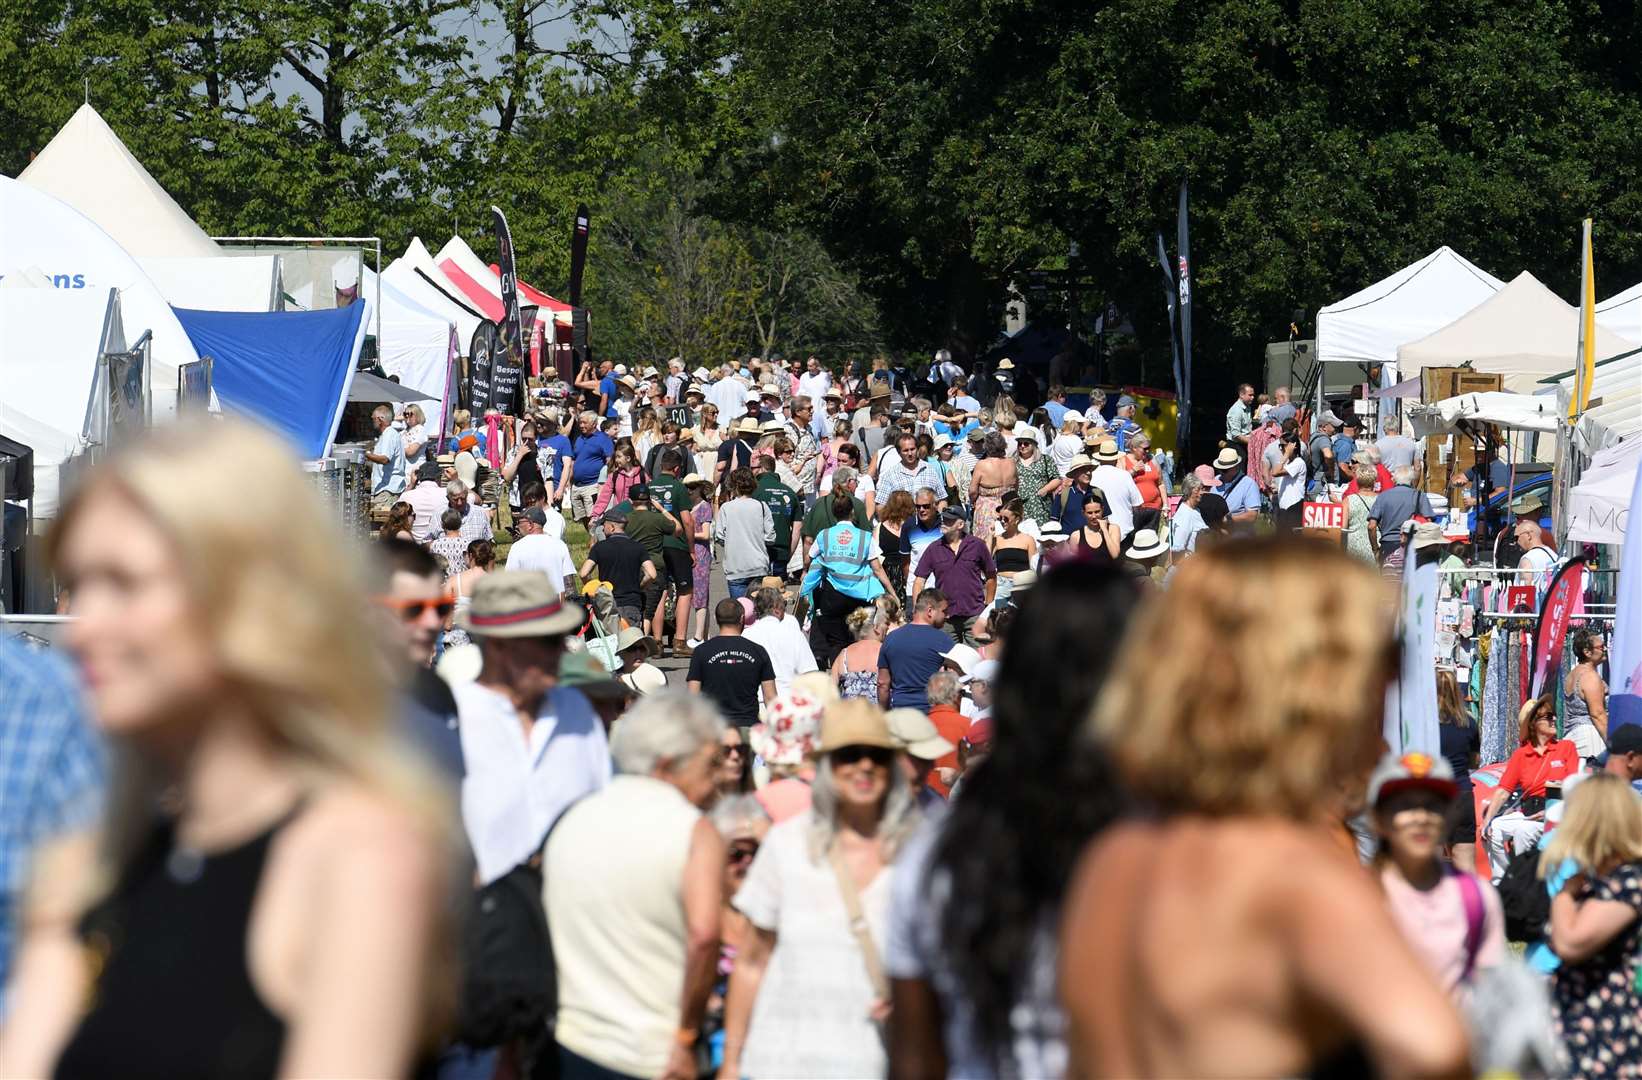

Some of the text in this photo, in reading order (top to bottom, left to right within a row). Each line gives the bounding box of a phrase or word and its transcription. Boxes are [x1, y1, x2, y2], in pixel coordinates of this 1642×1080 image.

[496, 365, 520, 375] Bespo
[494, 376, 517, 384] Furnit
[1304, 505, 1343, 528] SALE
[708, 650, 756, 664] TOMMY HILFIGER
